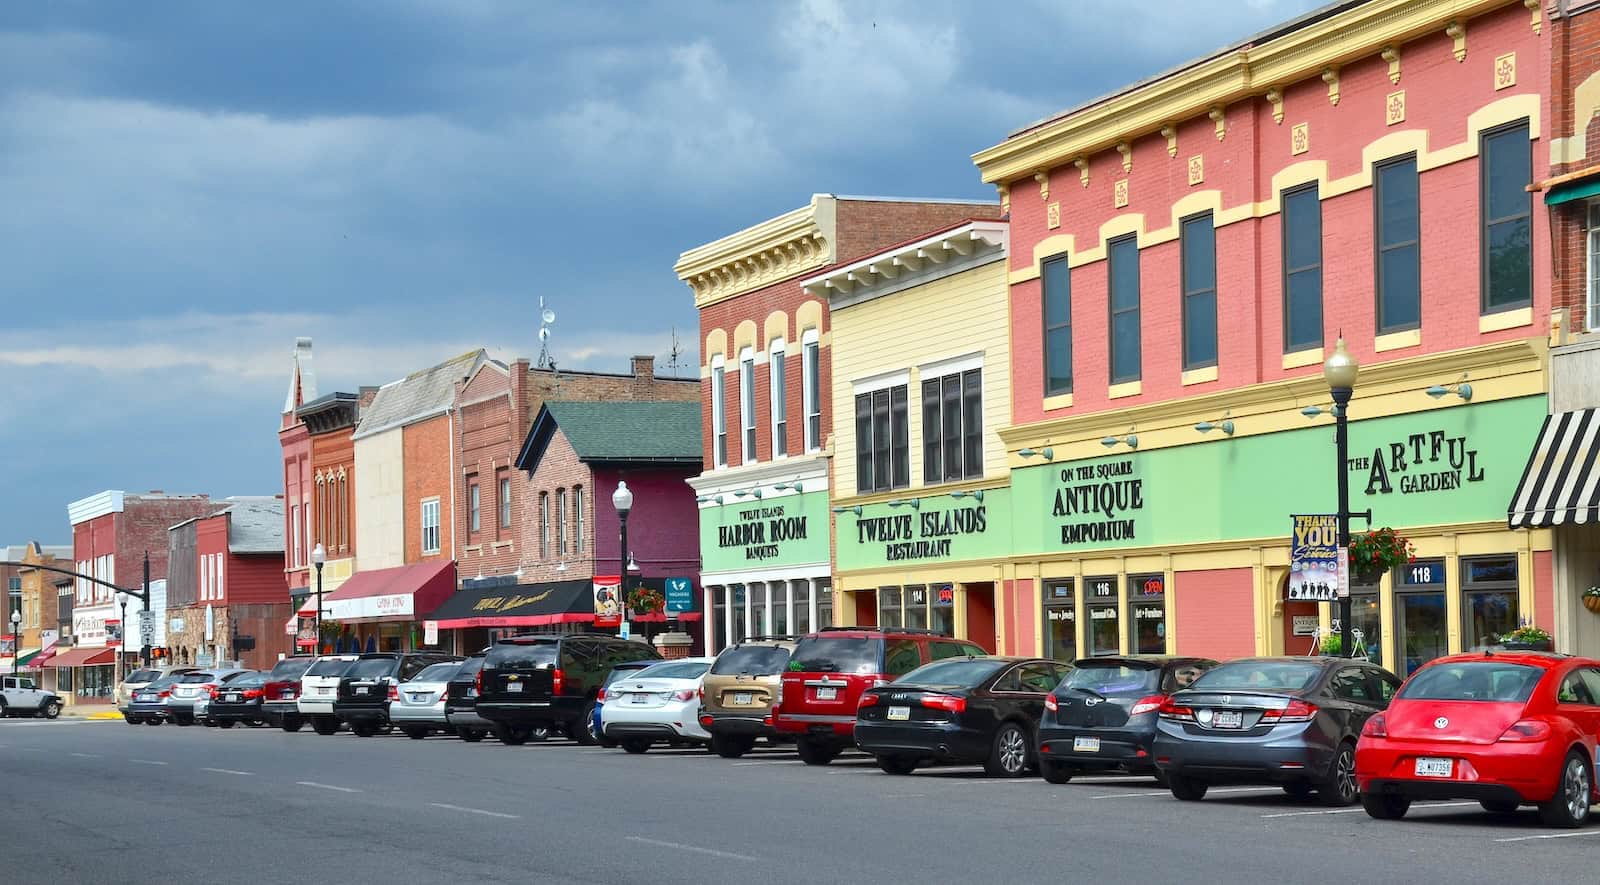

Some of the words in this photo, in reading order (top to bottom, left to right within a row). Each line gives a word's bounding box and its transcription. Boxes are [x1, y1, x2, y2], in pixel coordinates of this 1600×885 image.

[1061, 468, 1074, 482] ON
[1076, 466, 1095, 480] THE
[1097, 461, 1133, 480] SQUARE
[1348, 457, 1369, 471] THE
[1365, 430, 1485, 495] ARTFUL
[1400, 470, 1462, 494] GARDEN
[1053, 479, 1143, 518] ANTIQUE
[739, 509, 760, 521] TWELVE
[762, 506, 784, 519] ISLANDS
[1296, 516, 1336, 527] THANK
[718, 522, 766, 547] HARBOR
[770, 516, 808, 542] ROOM
[856, 514, 913, 543] TWELVE
[920, 506, 986, 538] ISLANDS
[1061, 519, 1135, 544] EMPORIUM
[1295, 527, 1336, 547] YOU
[746, 544, 779, 560] BANQUETS
[886, 539, 952, 561] RESTAURANT
[1412, 567, 1431, 583] 118
[912, 590, 923, 602] 114
[1096, 582, 1110, 596] 116
[1143, 580, 1163, 593] OPEN
[141, 624, 154, 633] 55
